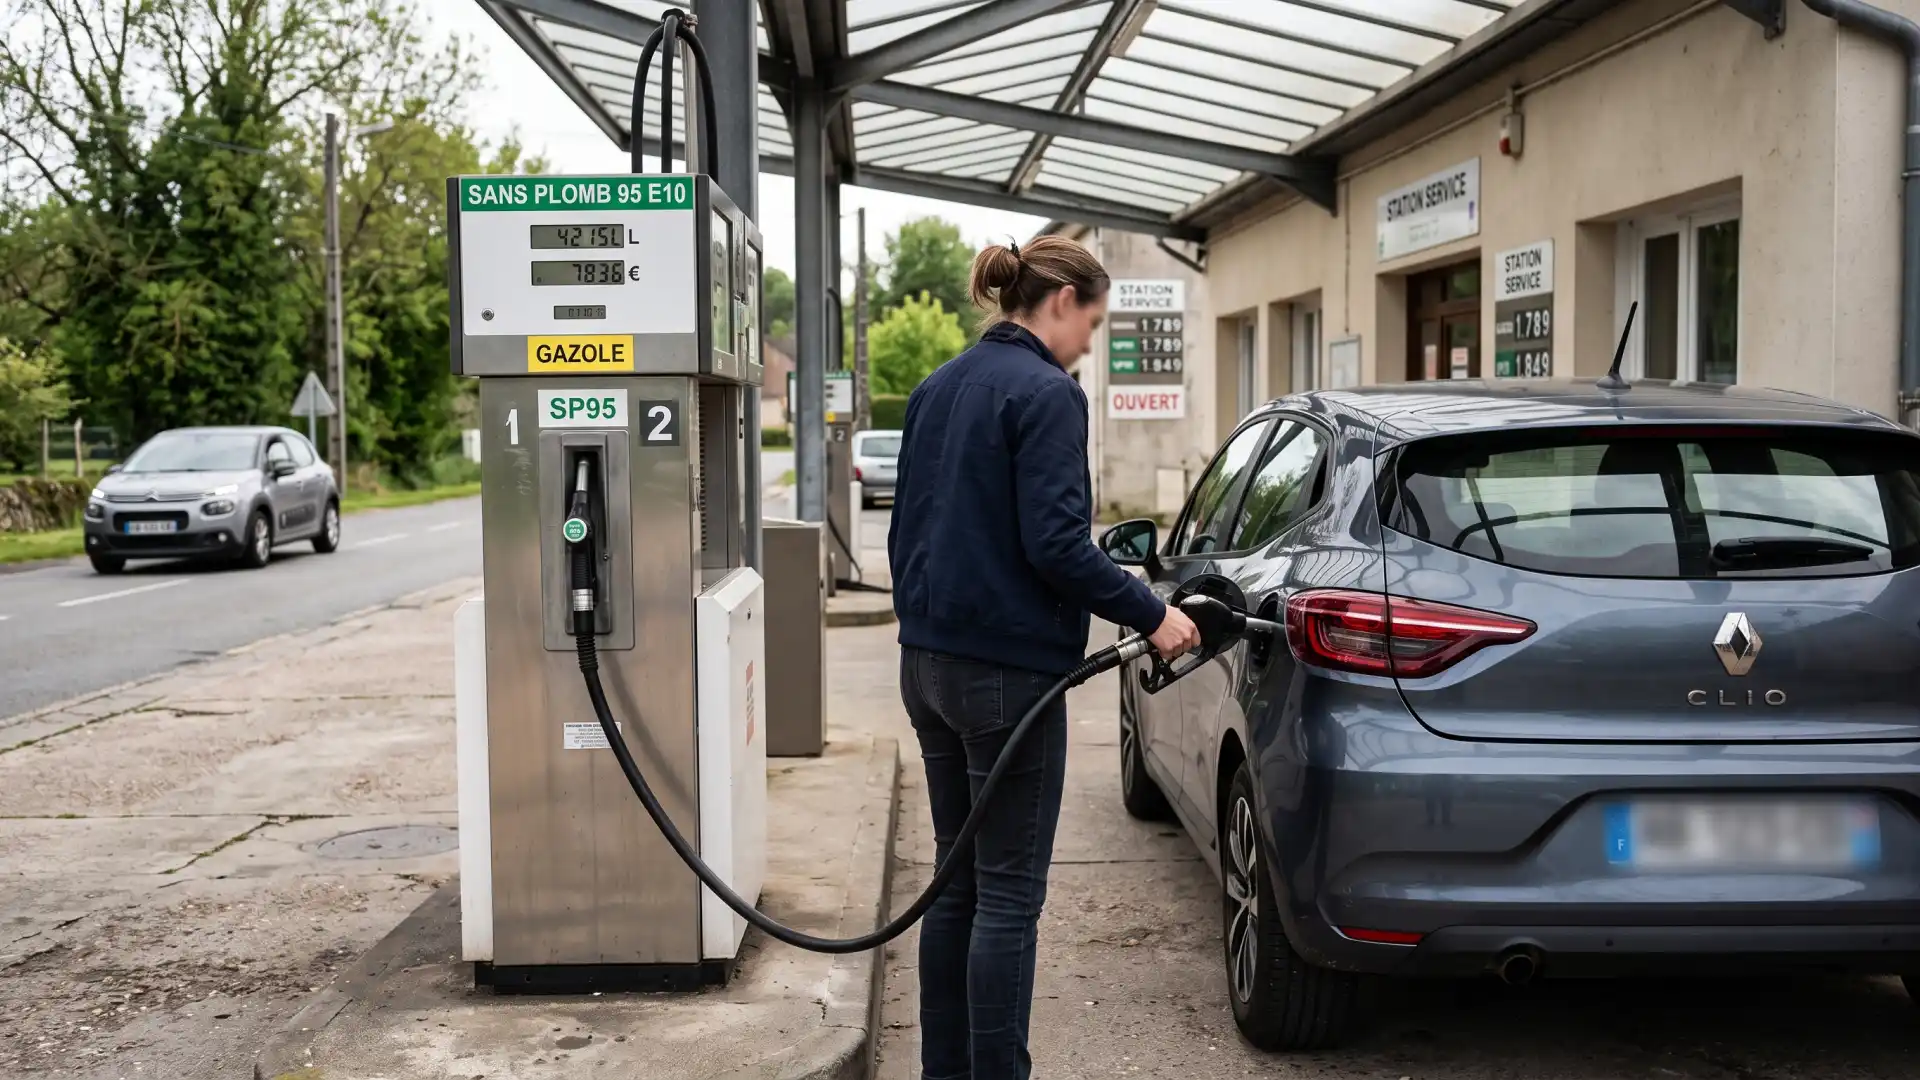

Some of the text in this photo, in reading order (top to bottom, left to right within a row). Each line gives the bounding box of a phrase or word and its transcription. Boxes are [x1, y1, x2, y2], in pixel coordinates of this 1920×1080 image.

[468, 182, 686, 204] SANS PLOMB 95 E10
[1425, 171, 1466, 208] SERVICE
[628, 228, 640, 245] L
[1504, 248, 1542, 273] STATION
[628, 265, 640, 282] €
[1504, 271, 1541, 294] SERVICE
[1119, 284, 1174, 295] STATION
[1119, 297, 1173, 308] SERVICE
[1141, 318, 1182, 333] 1789
[1516, 309, 1550, 339] 1.789
[536, 344, 625, 363] GAZOLE
[550, 397, 617, 420] SP95
[1113, 393, 1180, 410] OUVERT
[505, 408, 519, 445] 1
[647, 405, 673, 441] 2
[836, 430, 845, 442] 2
[1687, 689, 1787, 706] CLIO
[1617, 838, 1625, 851] F
